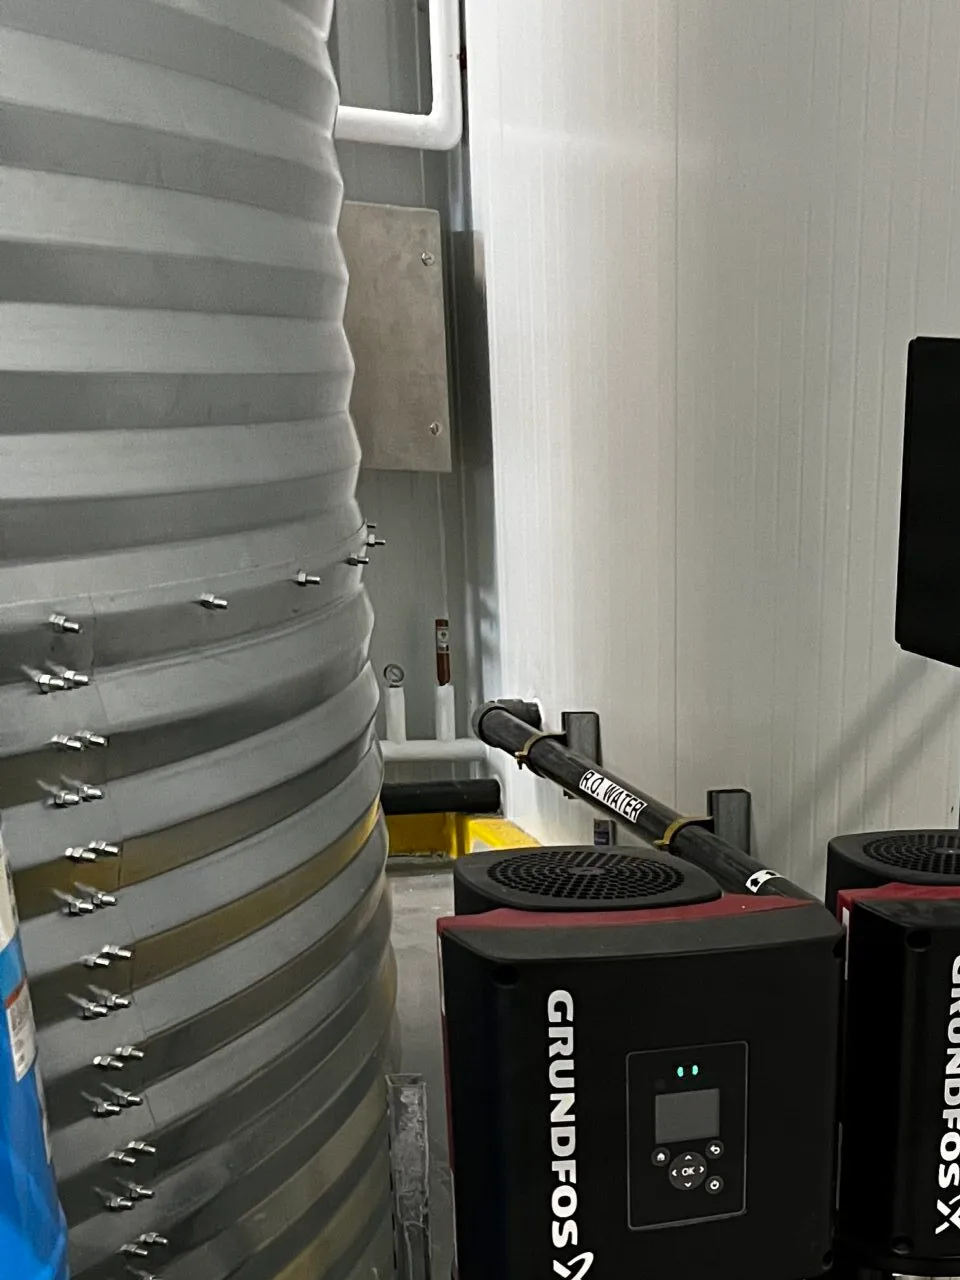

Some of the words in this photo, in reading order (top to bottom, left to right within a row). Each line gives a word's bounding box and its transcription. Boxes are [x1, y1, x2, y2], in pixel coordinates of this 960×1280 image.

[581, 771, 604, 797] R.O.
[603, 783, 645, 821] WATER
[547, 989, 578, 1249] GRUNDFOS
[682, 1167, 695, 1176] OK
